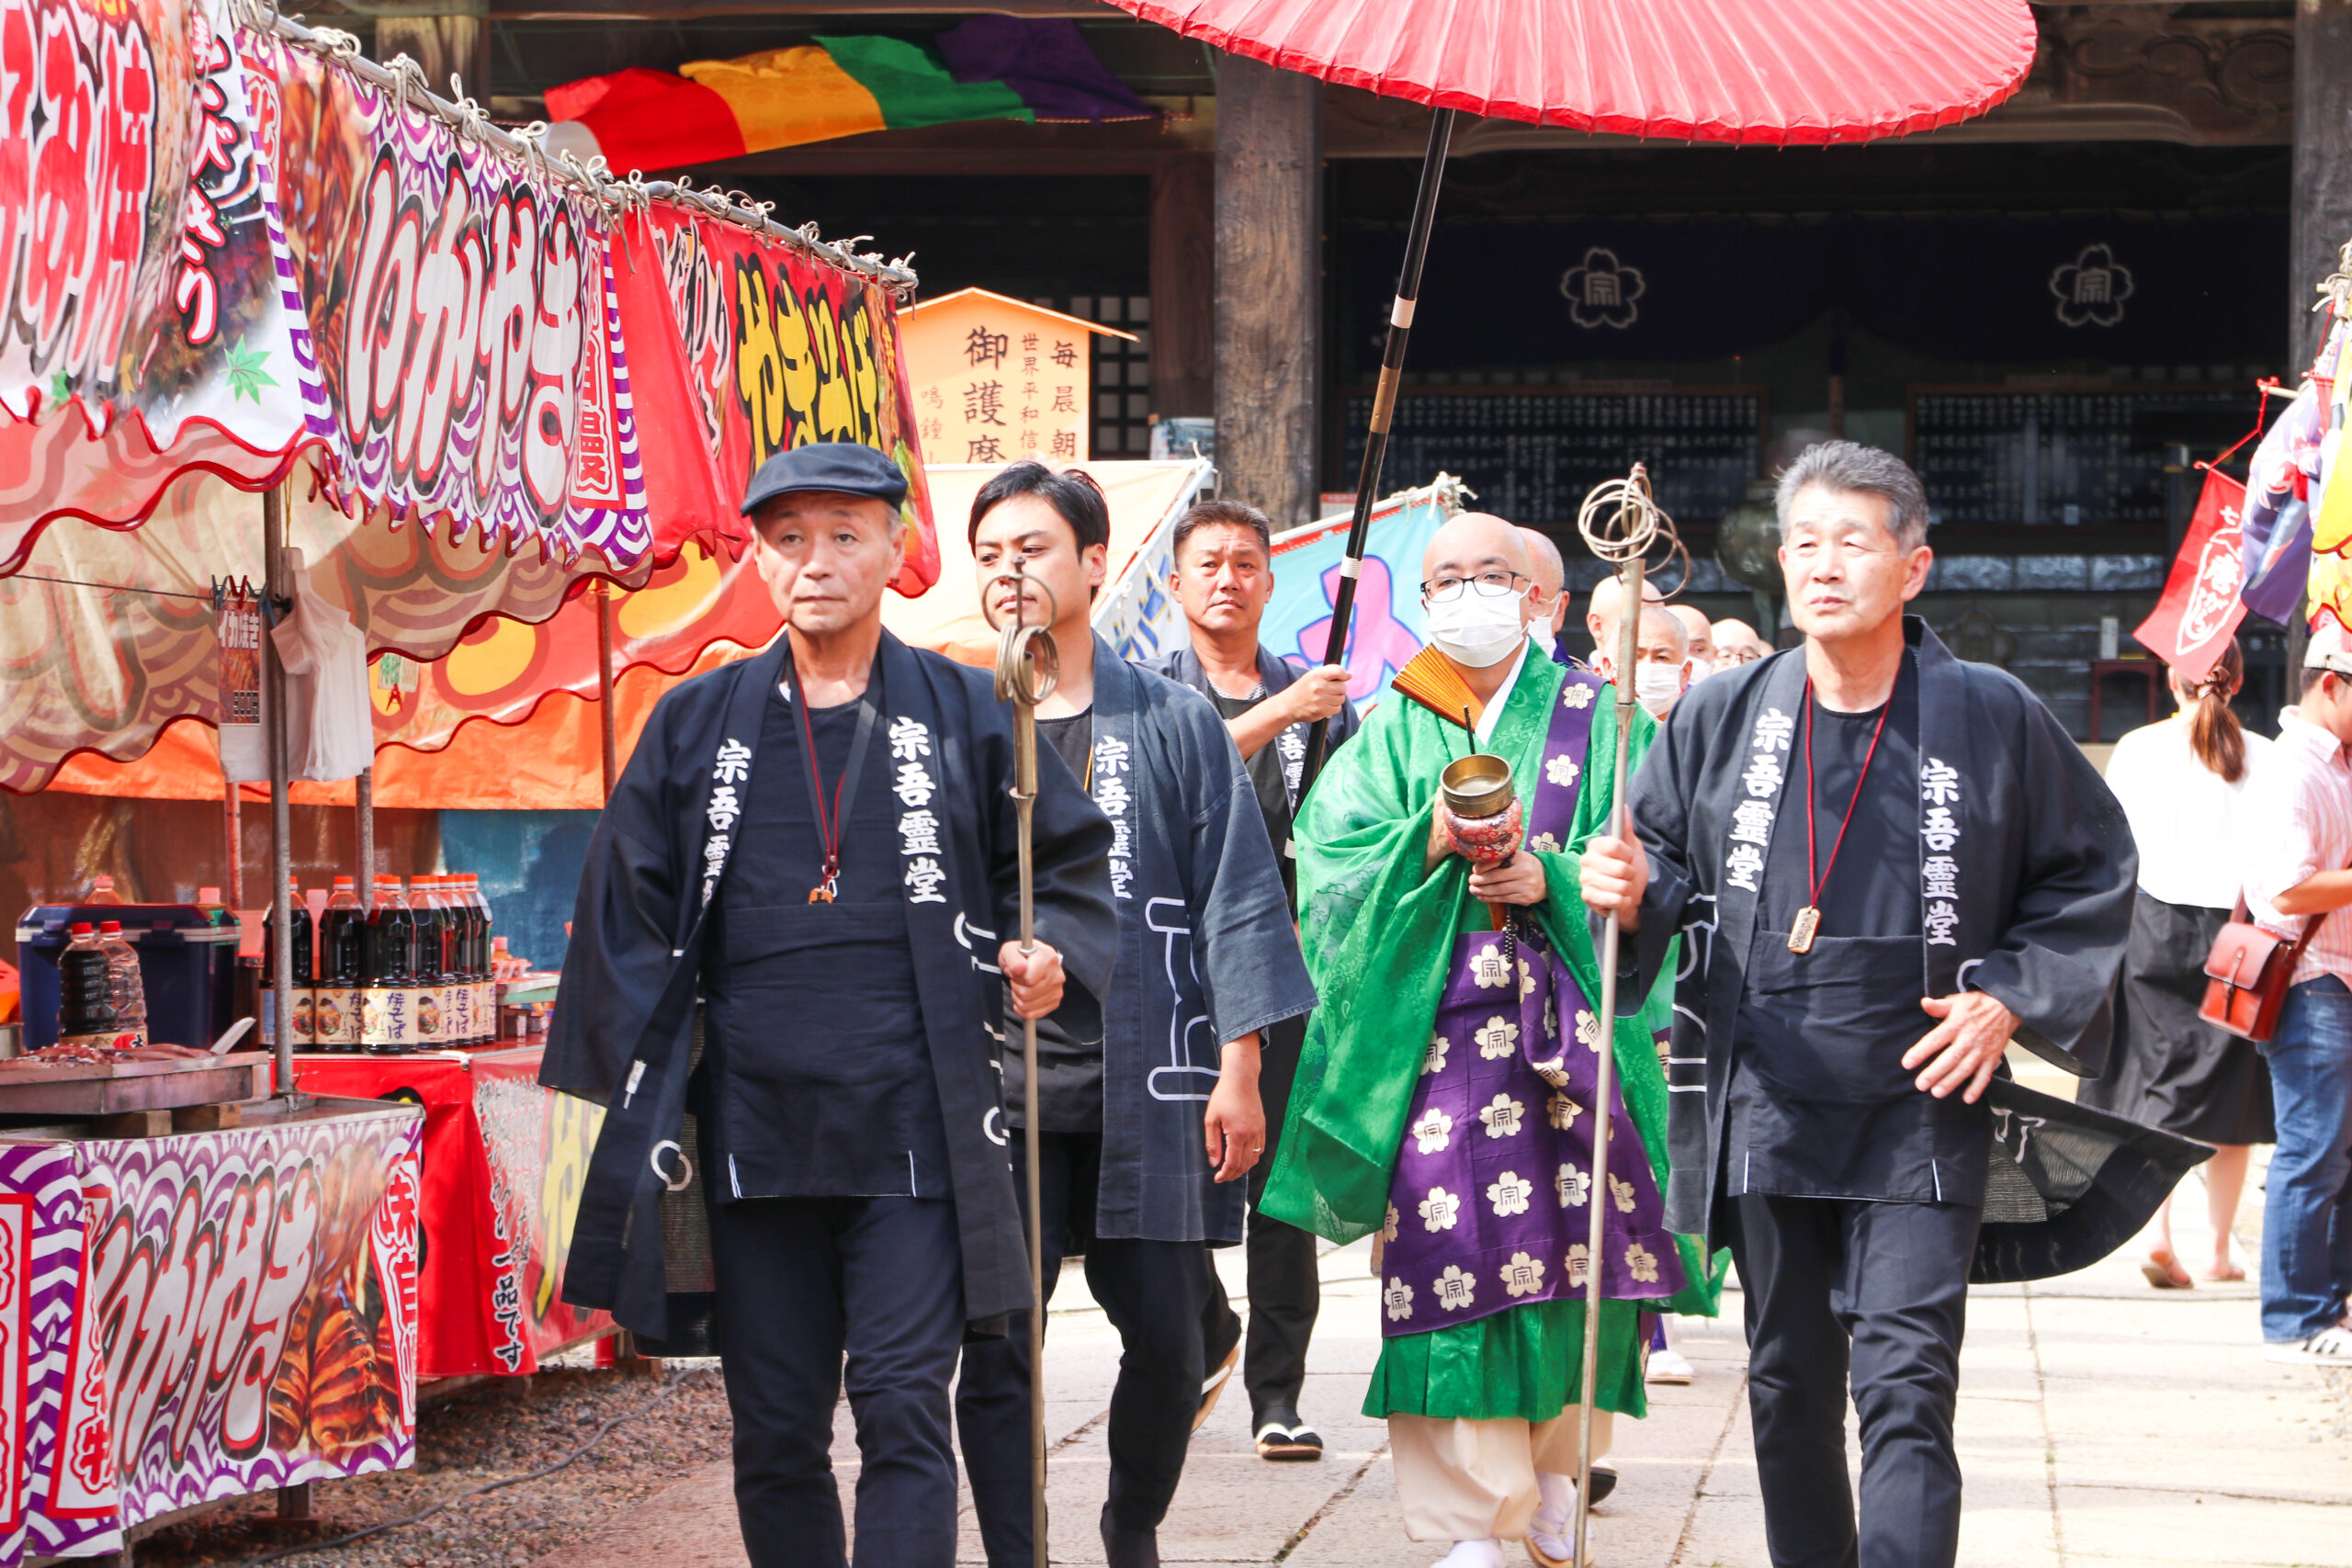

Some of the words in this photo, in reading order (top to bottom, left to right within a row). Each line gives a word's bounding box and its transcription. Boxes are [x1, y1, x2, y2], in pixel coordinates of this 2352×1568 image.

[342, 138, 584, 528] いかやき
[387, 992, 406, 1039] 焼そば
